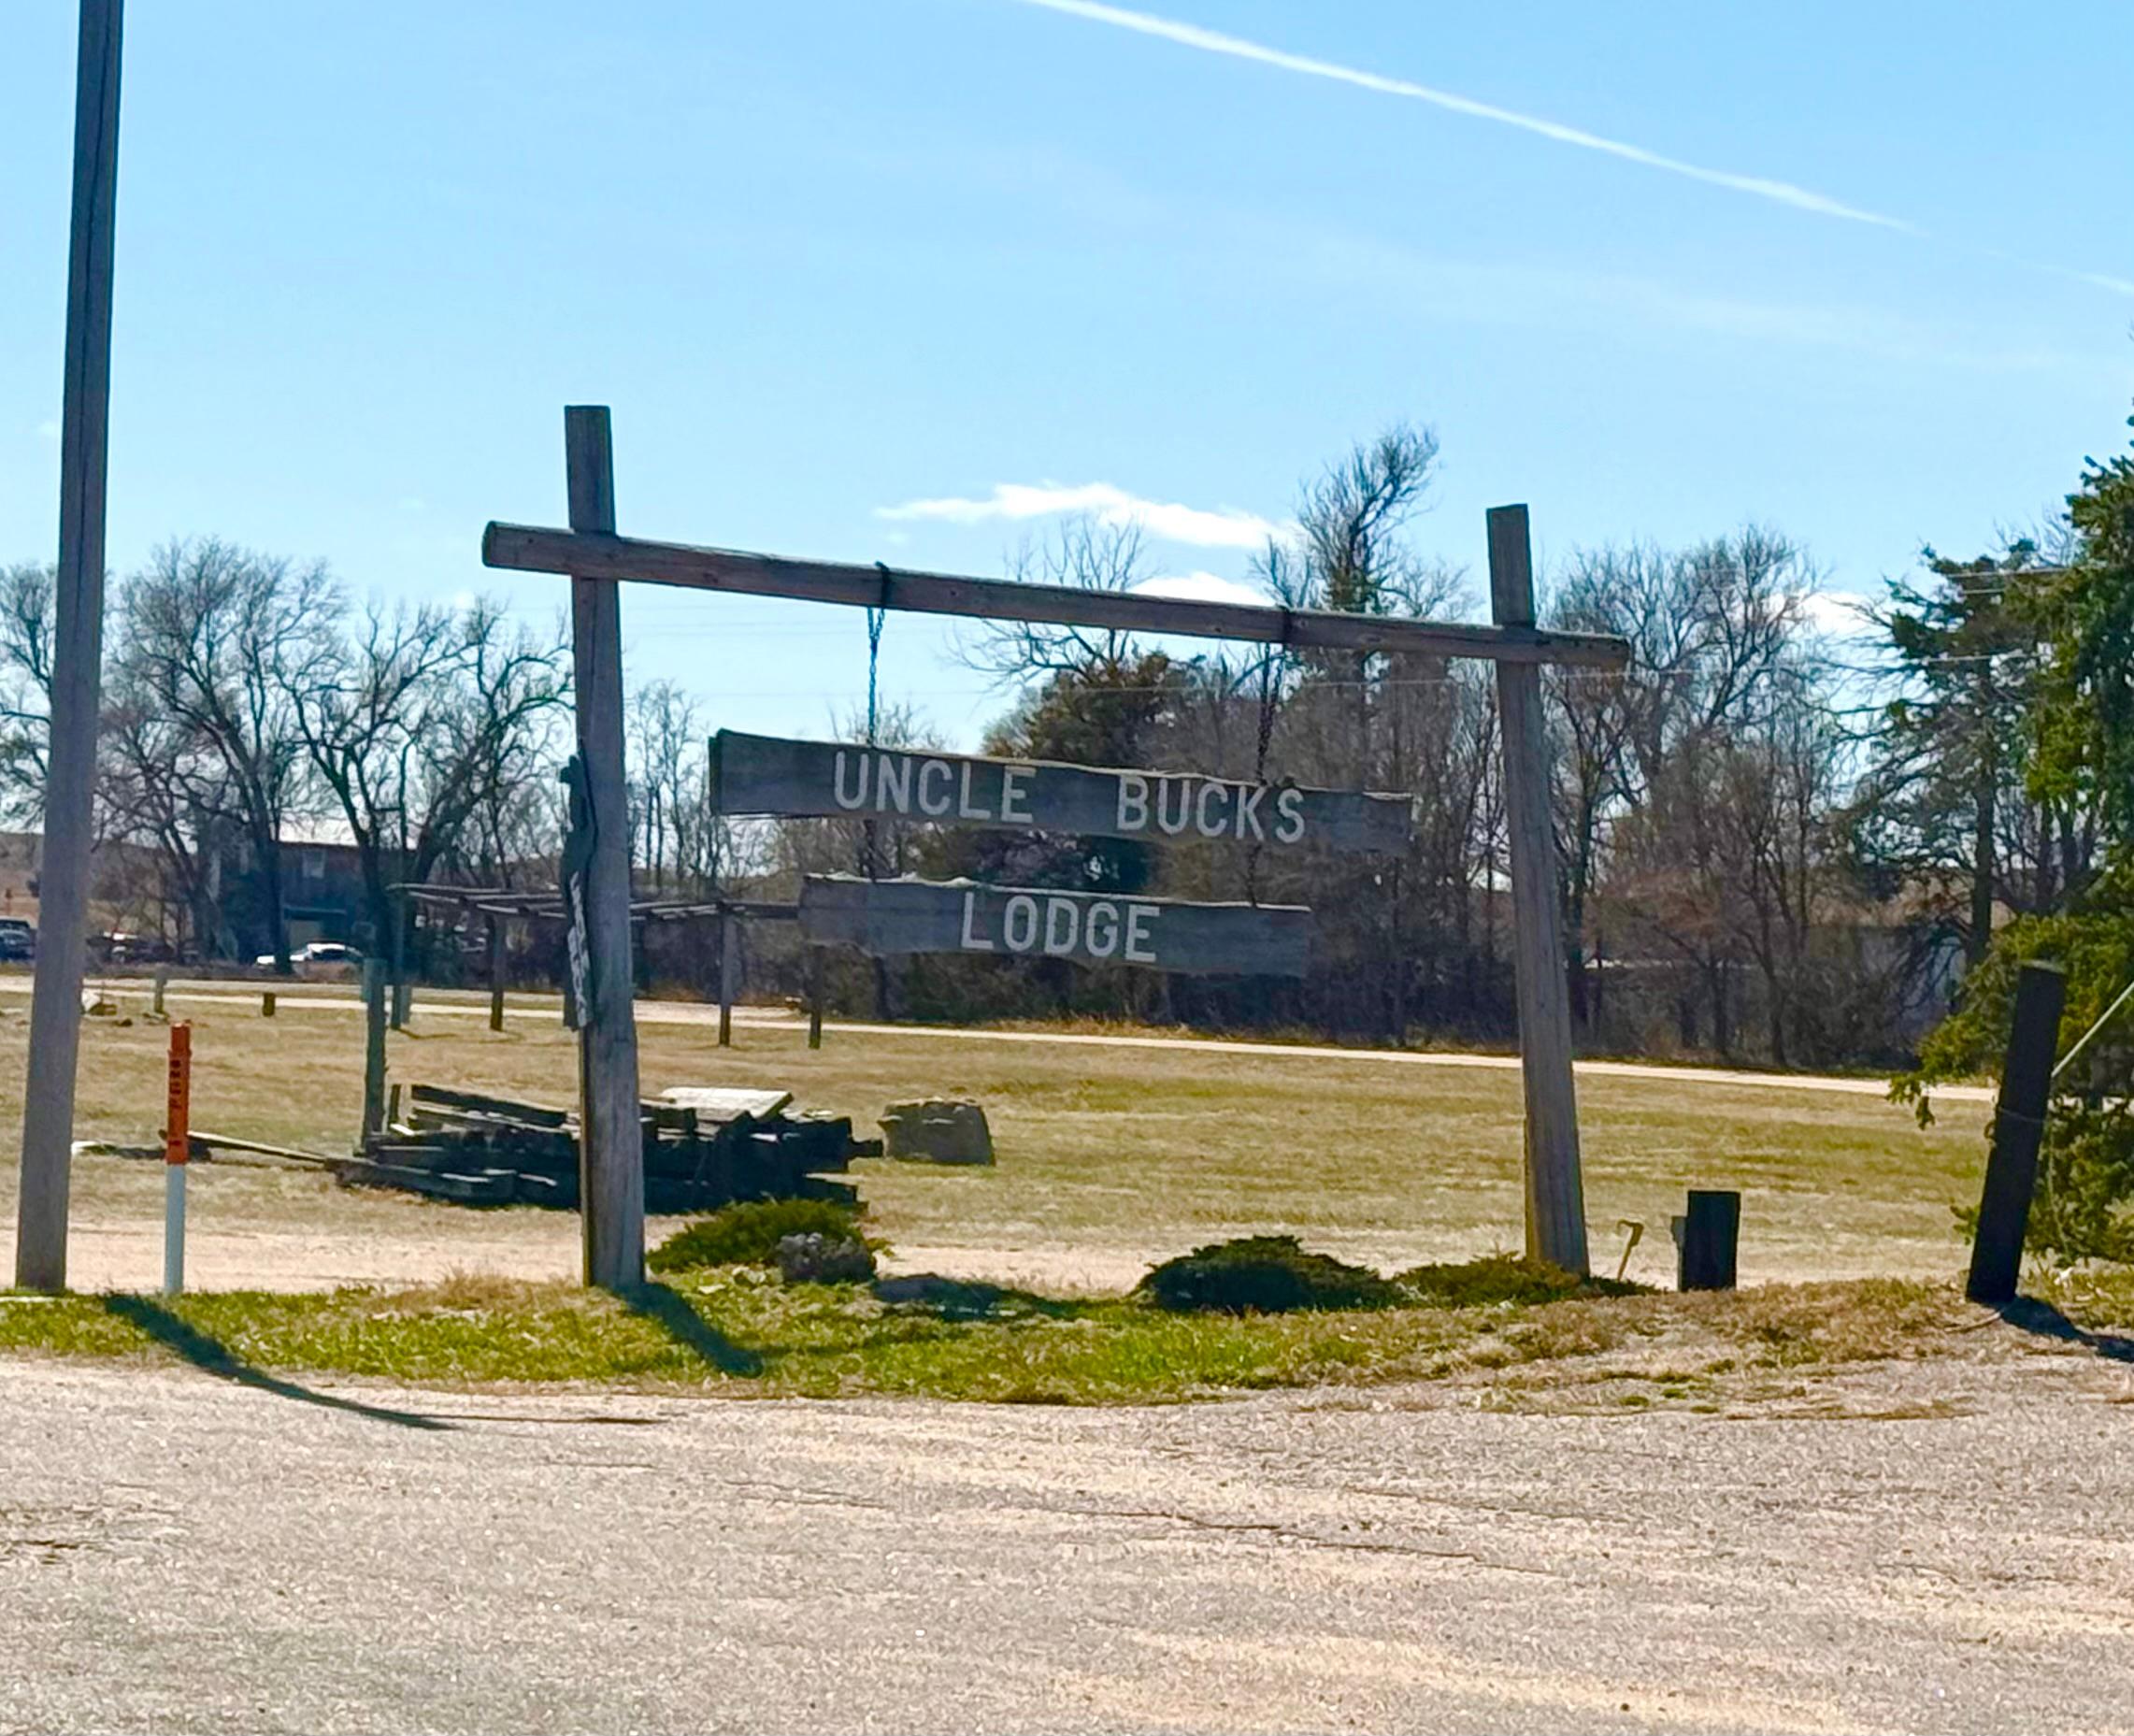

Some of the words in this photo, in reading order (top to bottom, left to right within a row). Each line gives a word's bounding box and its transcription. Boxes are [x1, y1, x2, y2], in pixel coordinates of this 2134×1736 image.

[834, 752, 1035, 824] UNCLE
[1117, 775, 1306, 842] BUCKS
[961, 892, 1160, 963] LODGE
